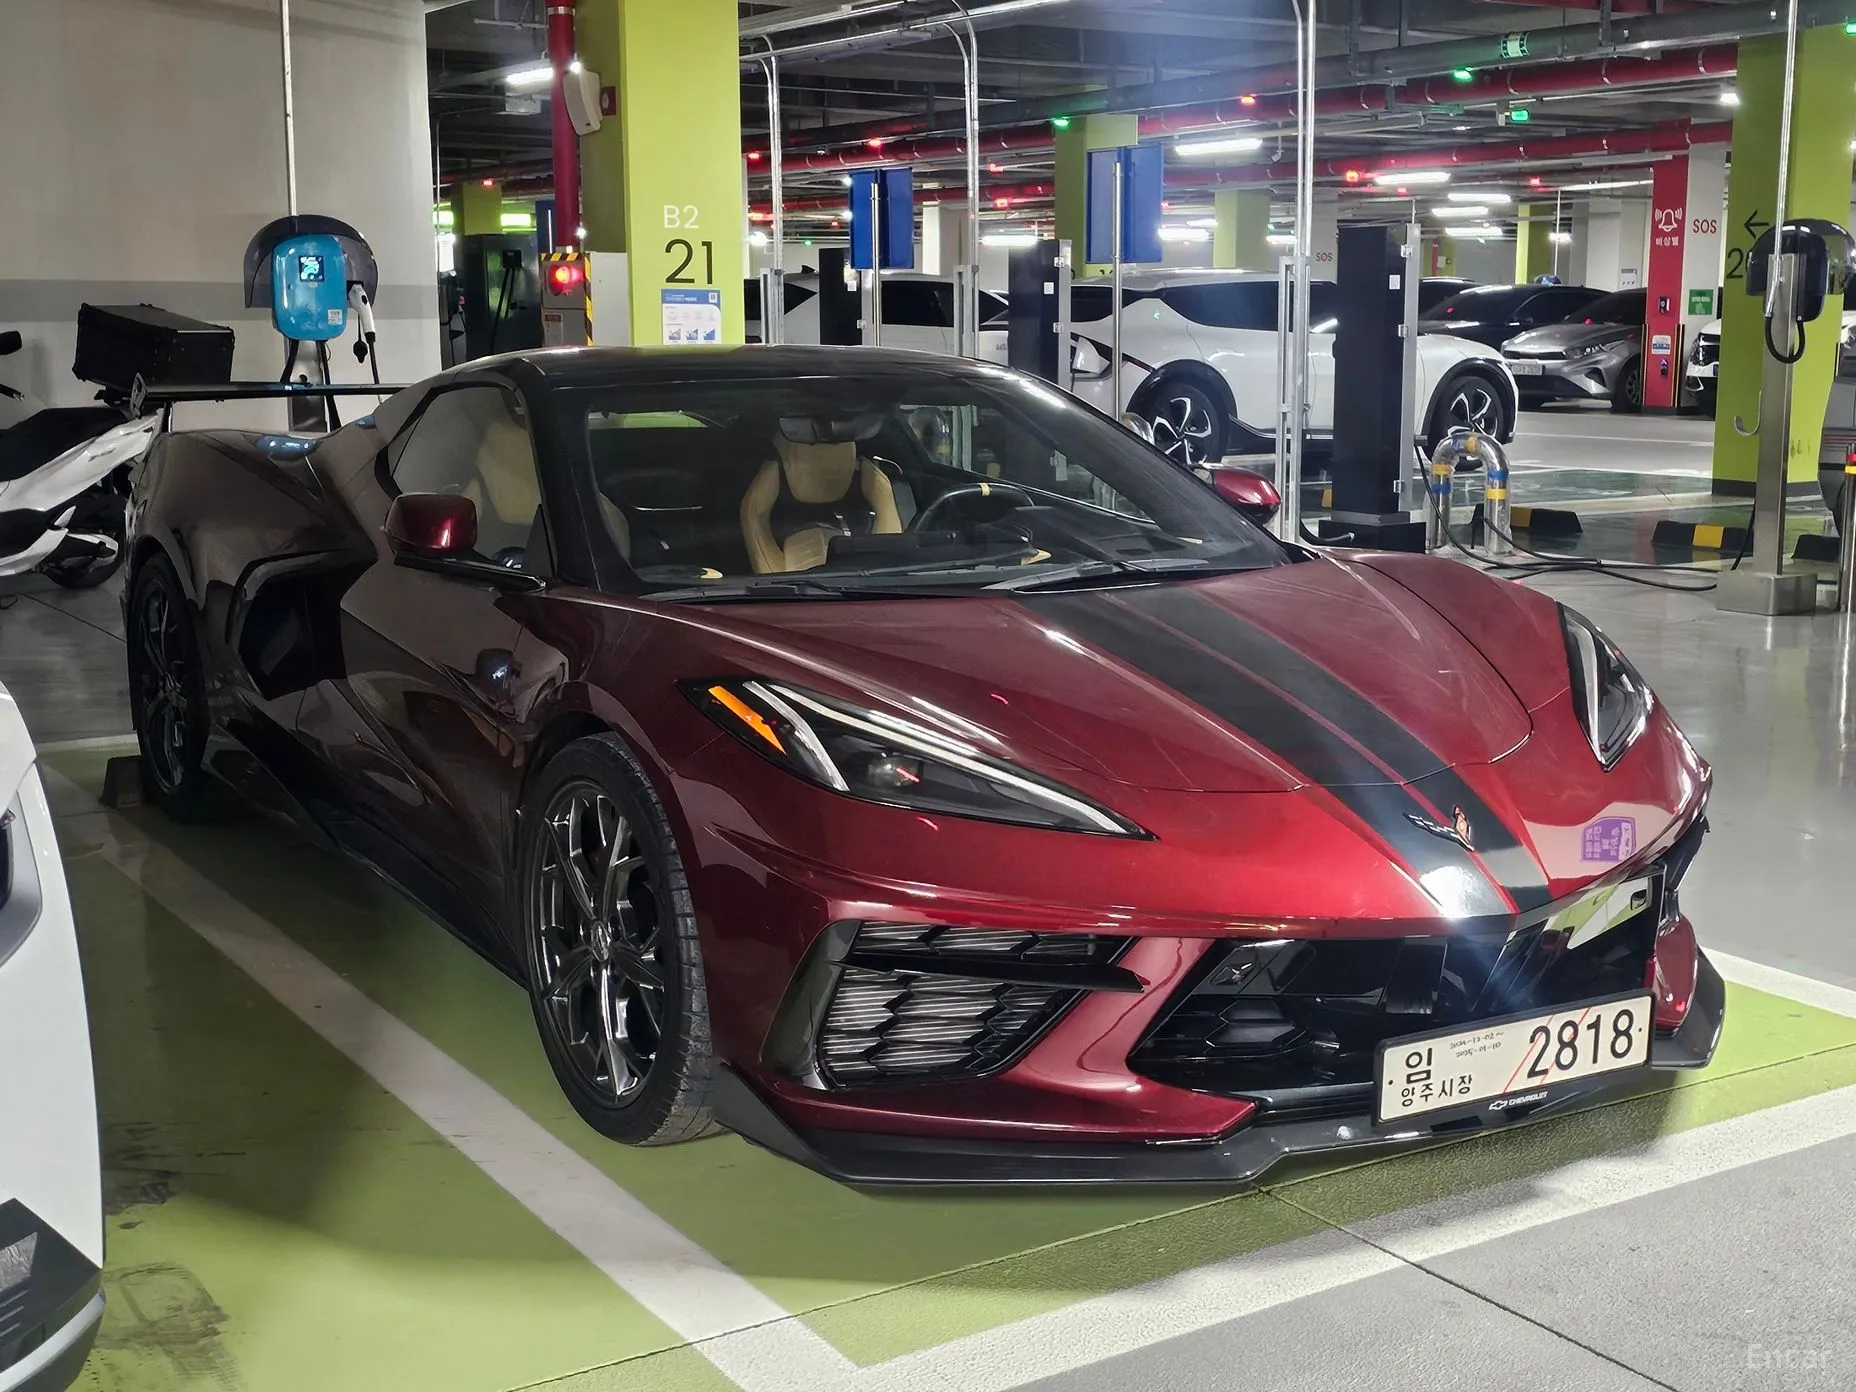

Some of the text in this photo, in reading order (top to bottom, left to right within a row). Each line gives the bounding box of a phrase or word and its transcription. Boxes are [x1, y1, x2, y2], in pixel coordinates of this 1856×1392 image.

[663, 204, 700, 229] B2
[1692, 218, 1718, 235] SOS
[664, 238, 714, 285] 21
[1315, 252, 1333, 262] SOS
[1526, 1008, 1635, 1080] 2818
[1405, 1047, 1433, 1085] 임
[1401, 1074, 1473, 1107] 양주시장
[1508, 1091, 1548, 1106] CHEVROLET
